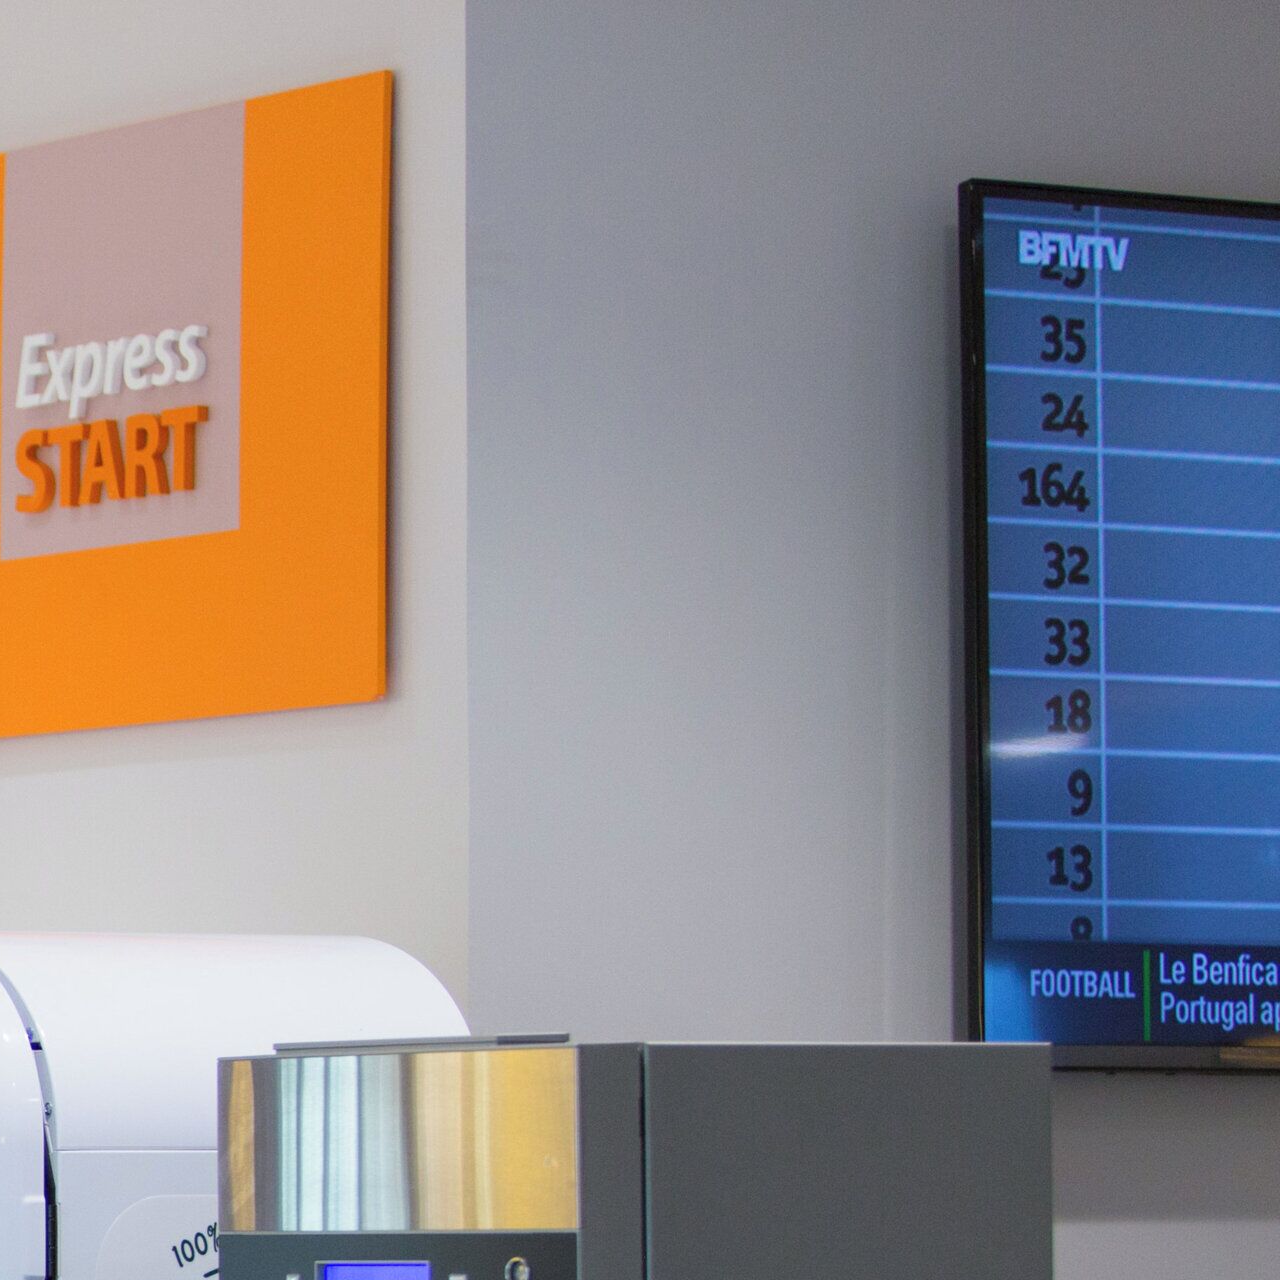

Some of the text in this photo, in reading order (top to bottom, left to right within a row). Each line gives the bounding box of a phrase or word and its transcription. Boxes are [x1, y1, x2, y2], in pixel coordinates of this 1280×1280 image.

[1019, 229, 1130, 271] BFMTV
[1040, 315, 1087, 364] 35
[15, 324, 209, 420] Express
[1041, 393, 1089, 438] 24
[15, 405, 209, 514] START
[1018, 462, 1091, 513] 164
[1043, 542, 1090, 590] 32
[1043, 618, 1091, 666] 33
[1045, 689, 1092, 734] 18
[1067, 769, 1093, 816] 9
[1047, 845, 1093, 892] 13
[1030, 969, 1136, 998] FOOTBALL
[1159, 952, 1278, 986] Le Benfica
[1160, 991, 1254, 1031] Portugal
